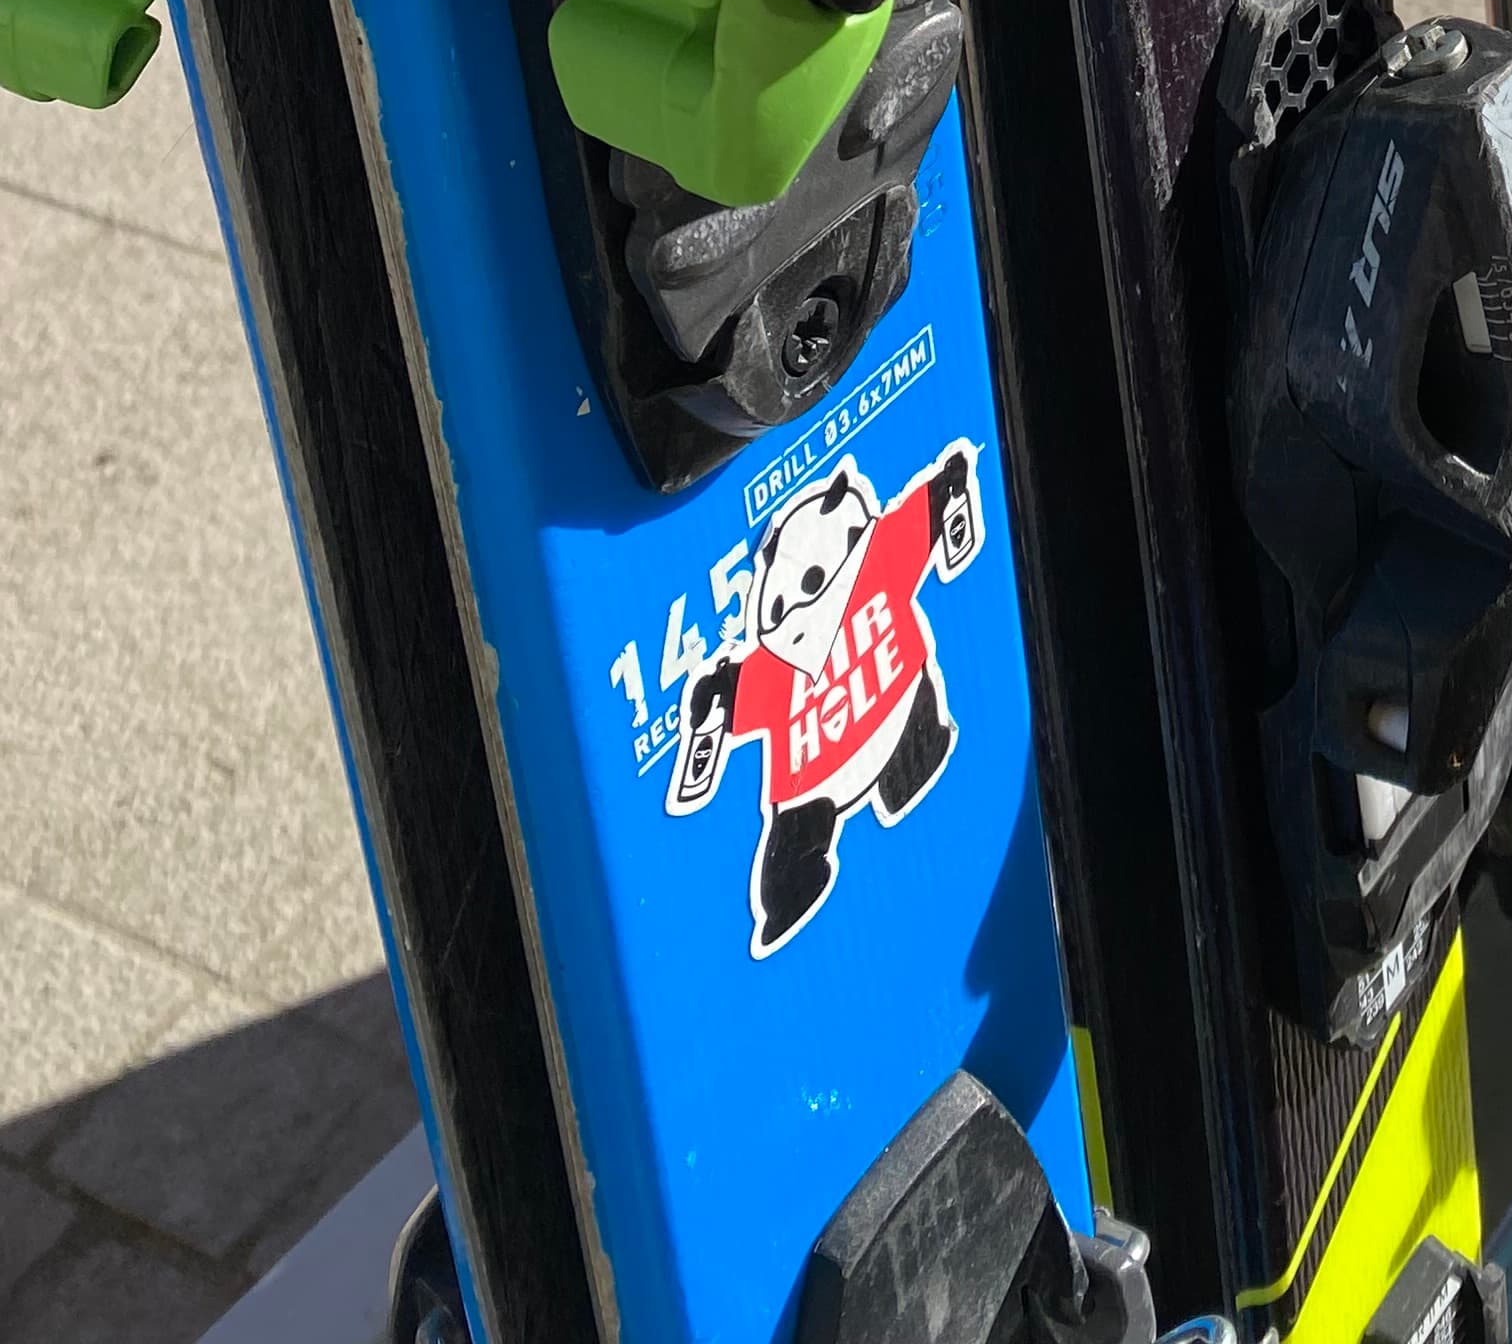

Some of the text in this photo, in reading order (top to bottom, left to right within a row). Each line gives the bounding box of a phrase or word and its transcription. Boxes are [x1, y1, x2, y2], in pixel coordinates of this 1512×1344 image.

[753, 443, 816, 510] DRILL
[610, 539, 752, 728] 145
[790, 591, 892, 720] AIR
[1386, 952, 1400, 988] M
